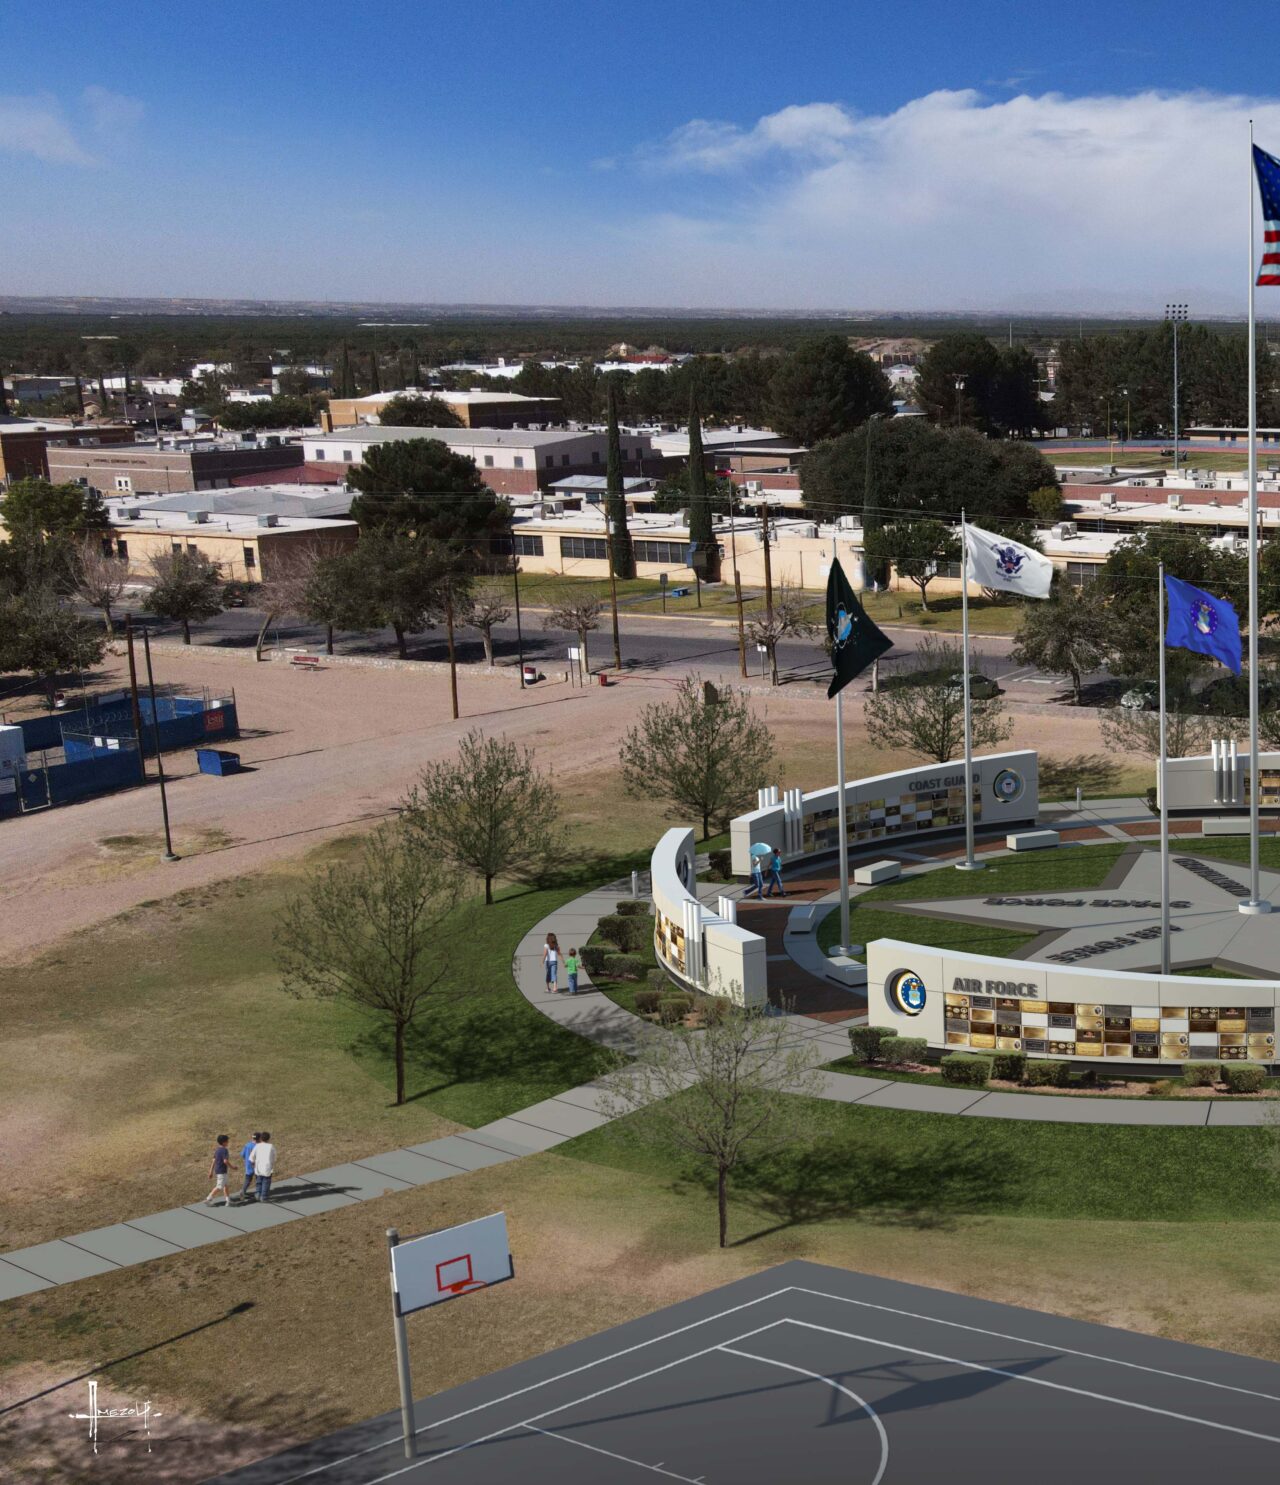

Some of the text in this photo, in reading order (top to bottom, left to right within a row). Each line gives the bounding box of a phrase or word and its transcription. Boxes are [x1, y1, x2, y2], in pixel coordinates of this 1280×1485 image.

[909, 774, 980, 791] COAST GUAD
[952, 977, 1038, 998] AIR FORCE
